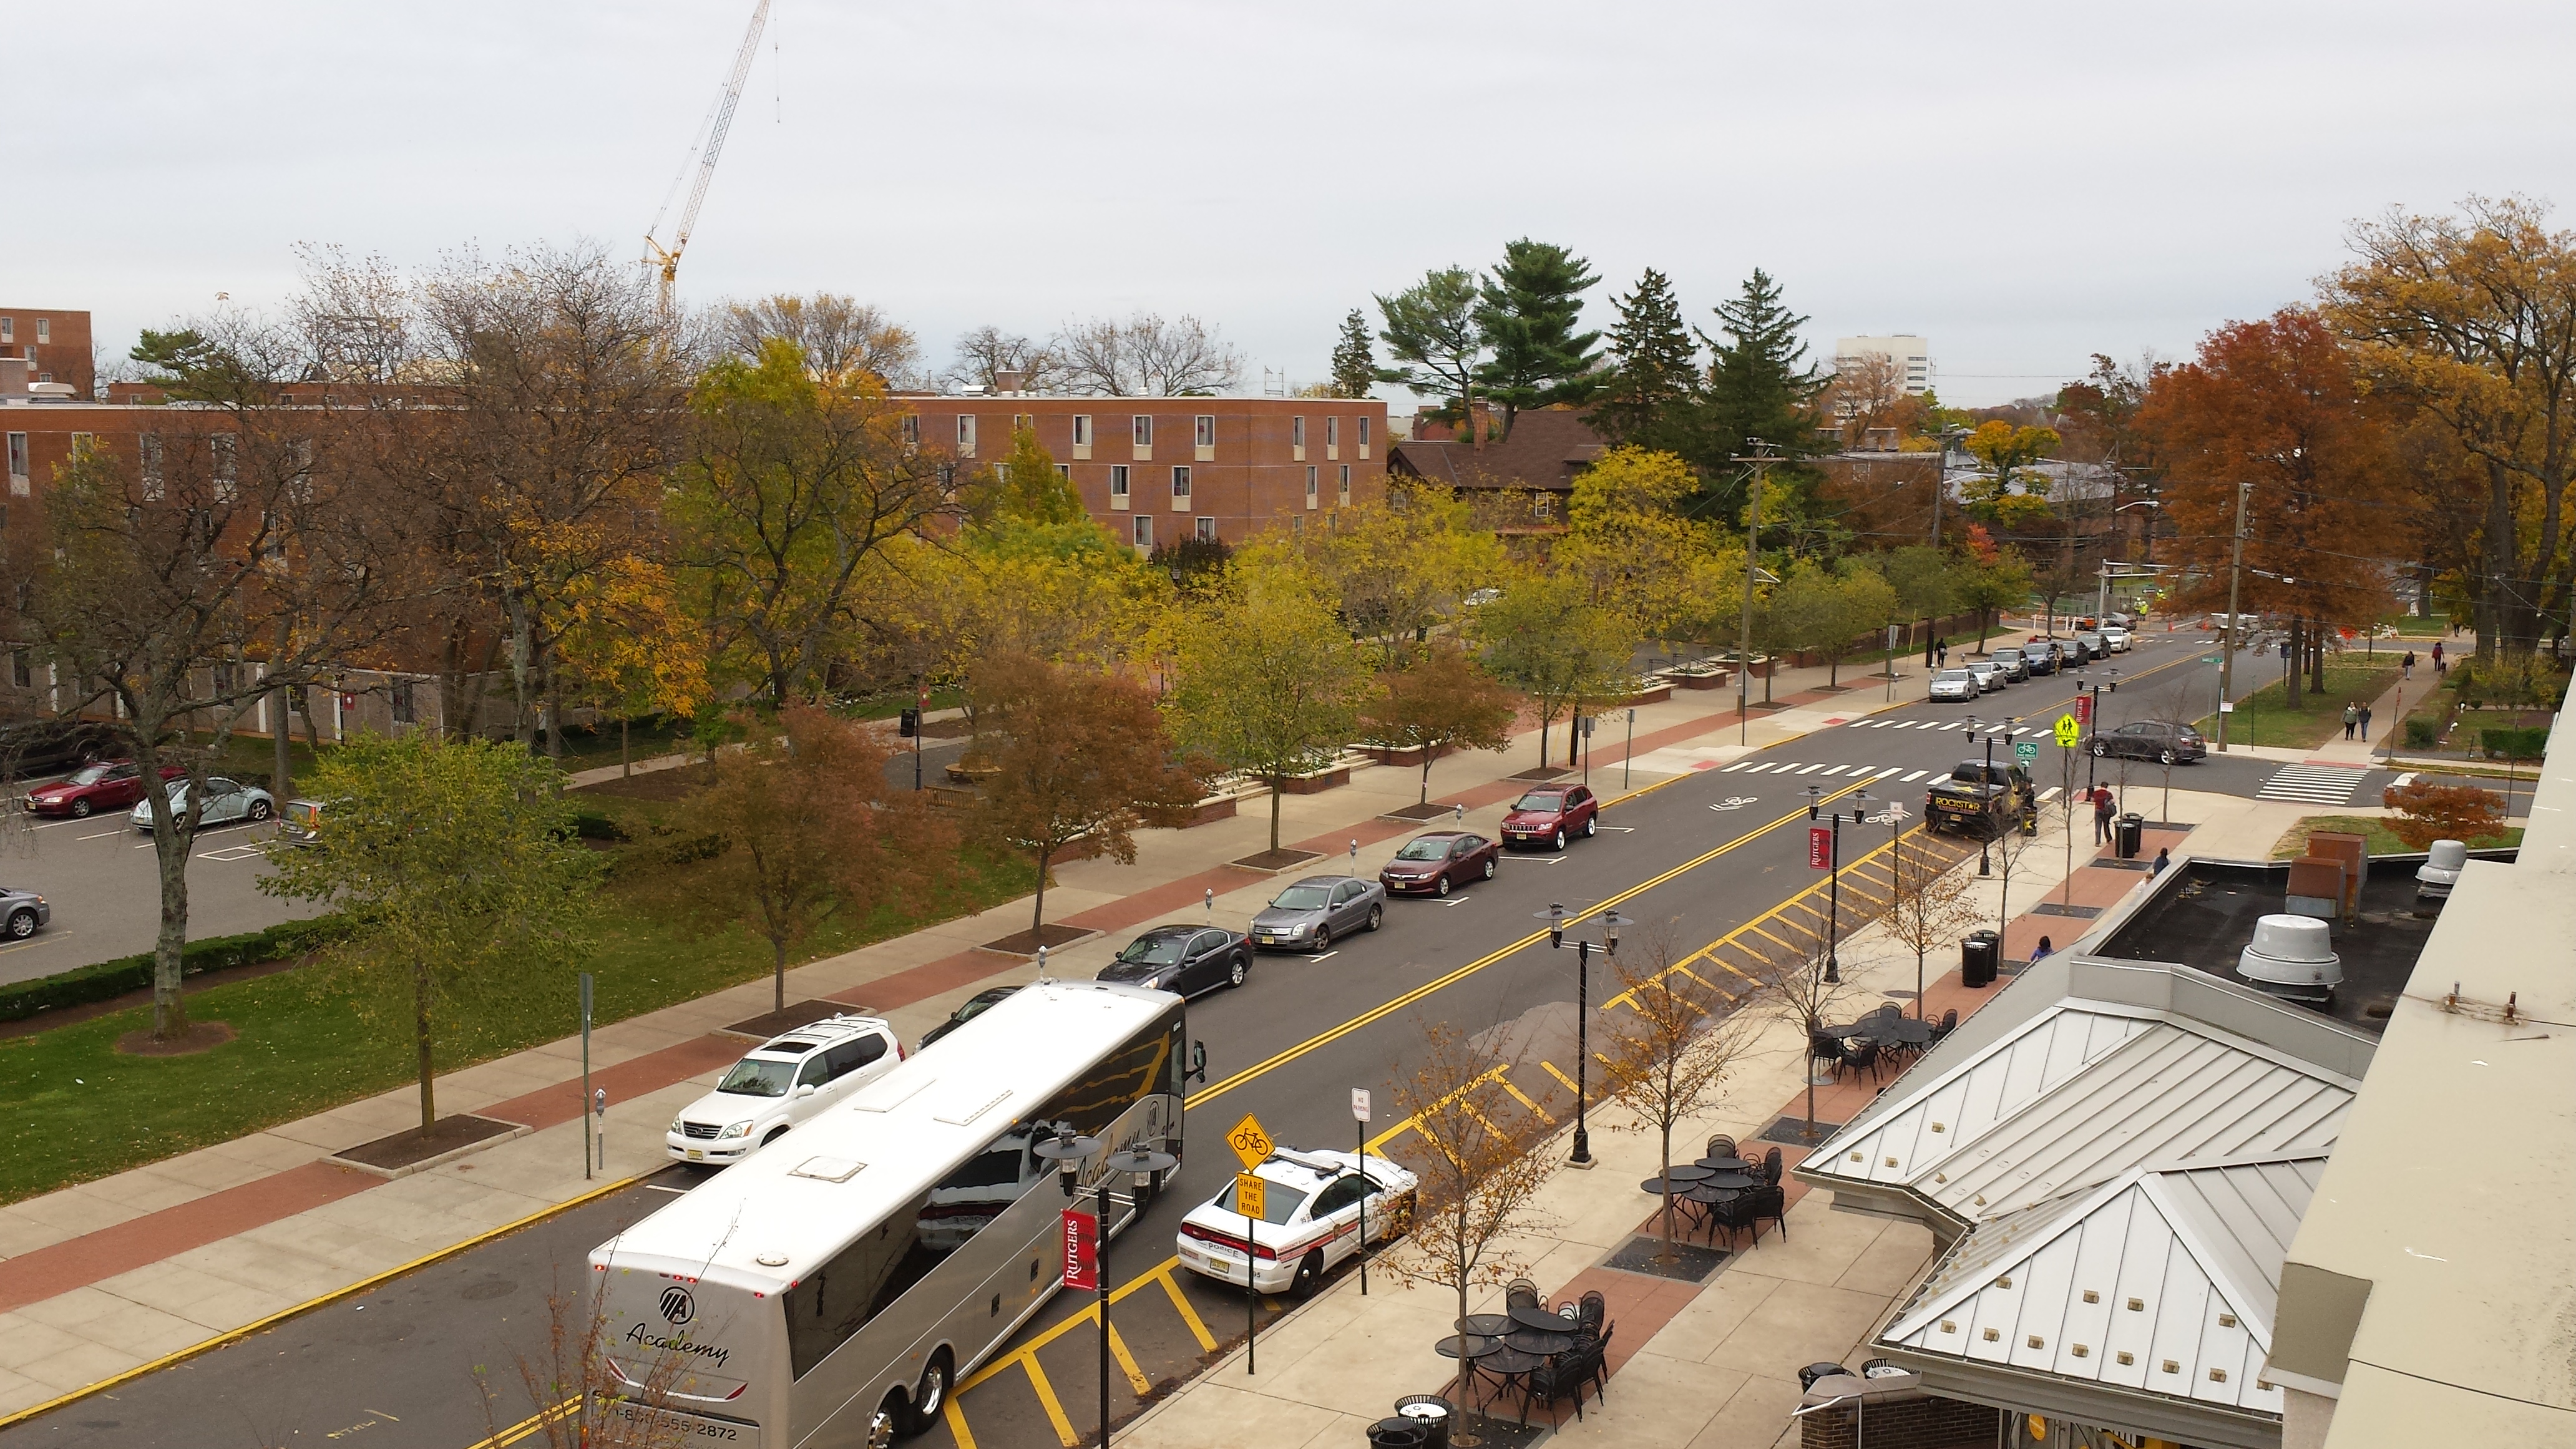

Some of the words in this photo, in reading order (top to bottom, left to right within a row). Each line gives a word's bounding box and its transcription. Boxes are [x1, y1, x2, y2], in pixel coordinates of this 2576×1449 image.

[1936, 797, 1980, 810] ROCKSTAR
[1812, 832, 1821, 866] RUTGERS
[1239, 1178, 1262, 1191] SHARE
[1245, 1191, 1257, 1202] THE
[1242, 1203, 1260, 1214] ROAD
[1066, 1219, 1082, 1280] RUTGERS
[1208, 1242, 1239, 1258] POLICE
[626, 1322, 729, 1368] Academy
